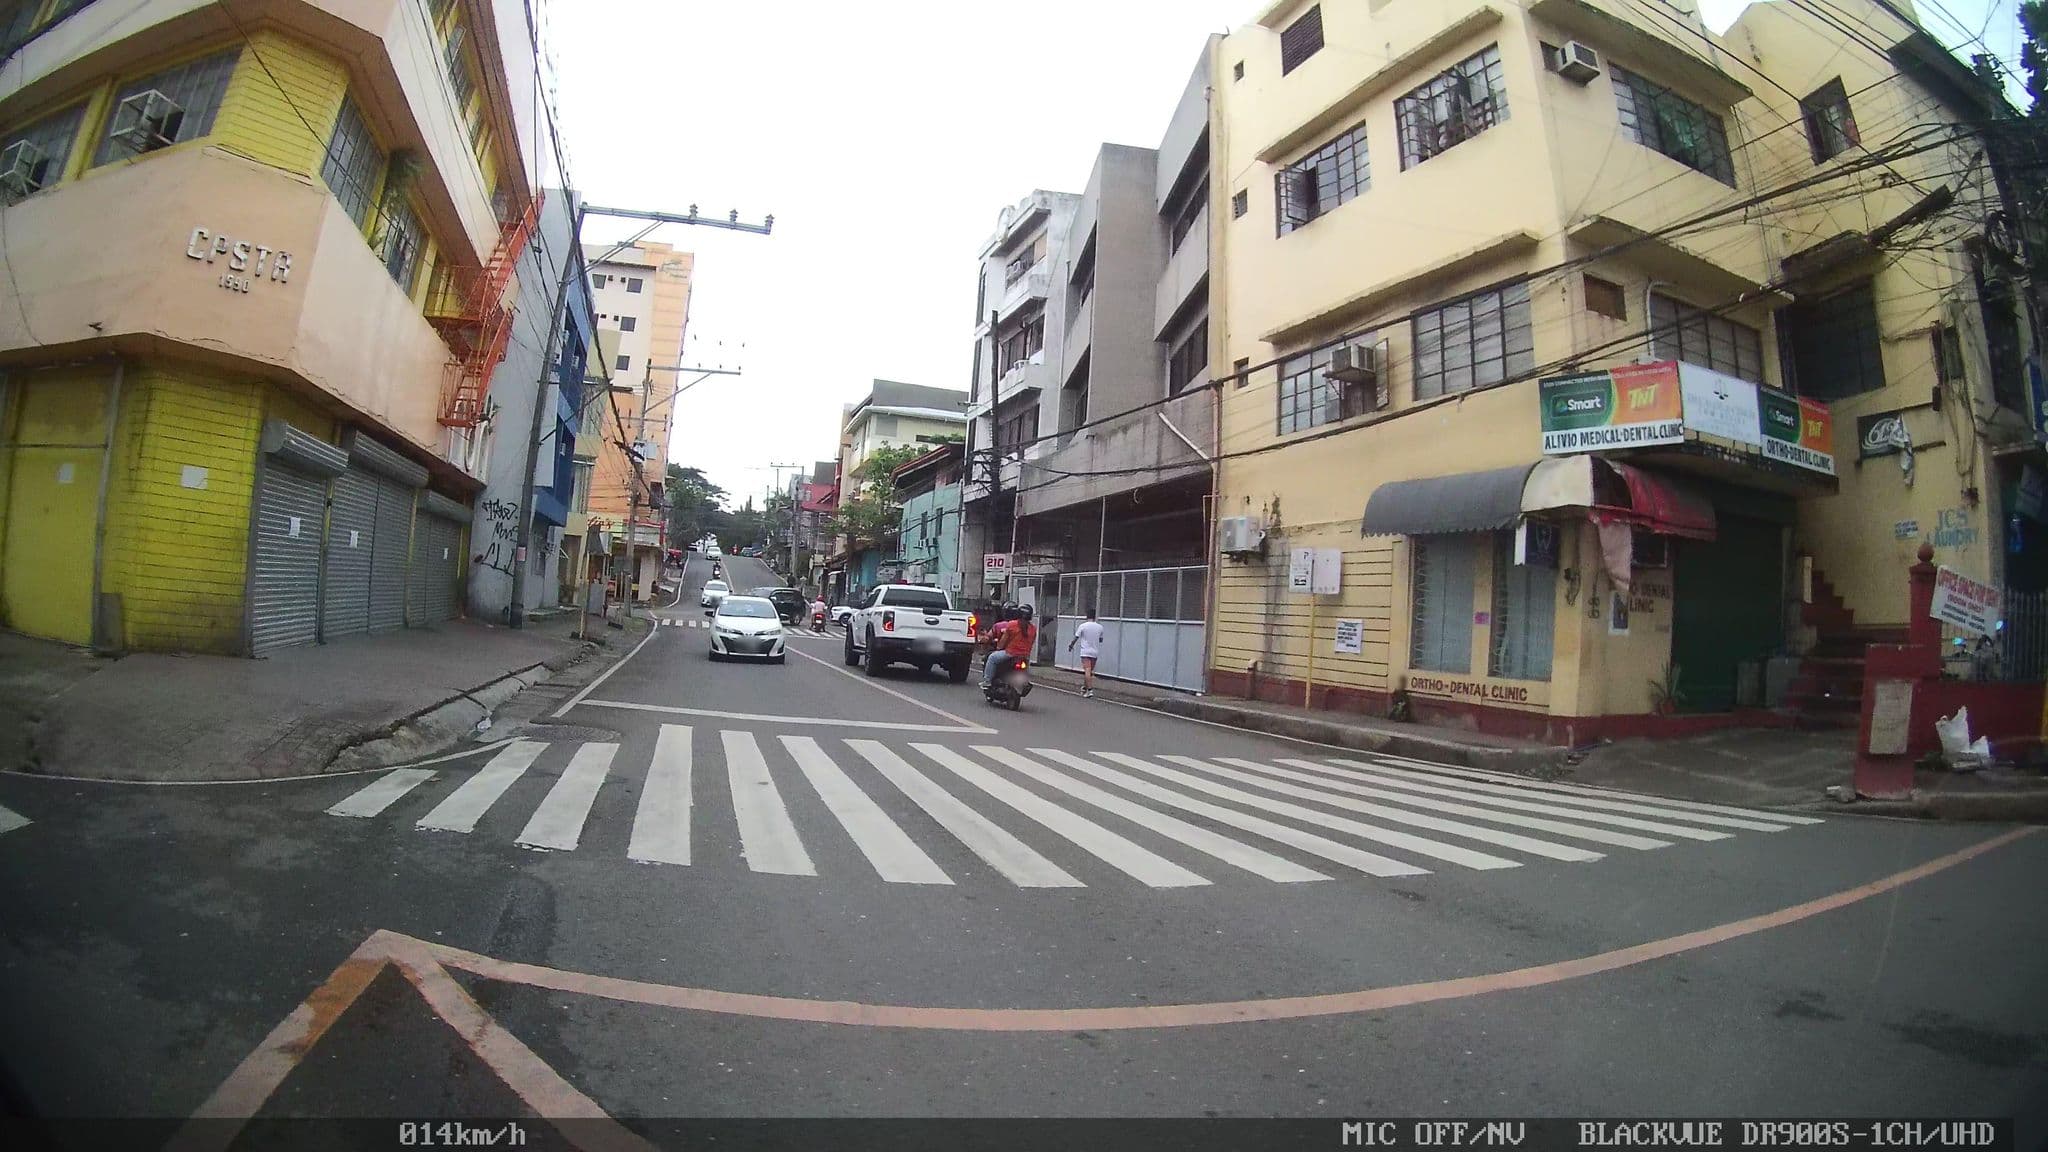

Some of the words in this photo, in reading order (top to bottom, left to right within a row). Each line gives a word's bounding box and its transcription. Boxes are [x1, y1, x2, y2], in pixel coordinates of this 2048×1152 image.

[186, 225, 293, 284] CPSTA
[1567, 396, 1602, 411] Smart
[1628, 382, 1660, 410] TNT
[1775, 409, 1796, 428] Smart
[1544, 432, 1578, 450] ALIVIO
[1659, 422, 1684, 438] CLINIC
[1807, 420, 1824, 438] TNT
[1813, 453, 1831, 471] CLINIC
[987, 558, 1005, 567] 210
[1629, 598, 1654, 614] LINIC
[1490, 684, 1528, 702] CLINIC
